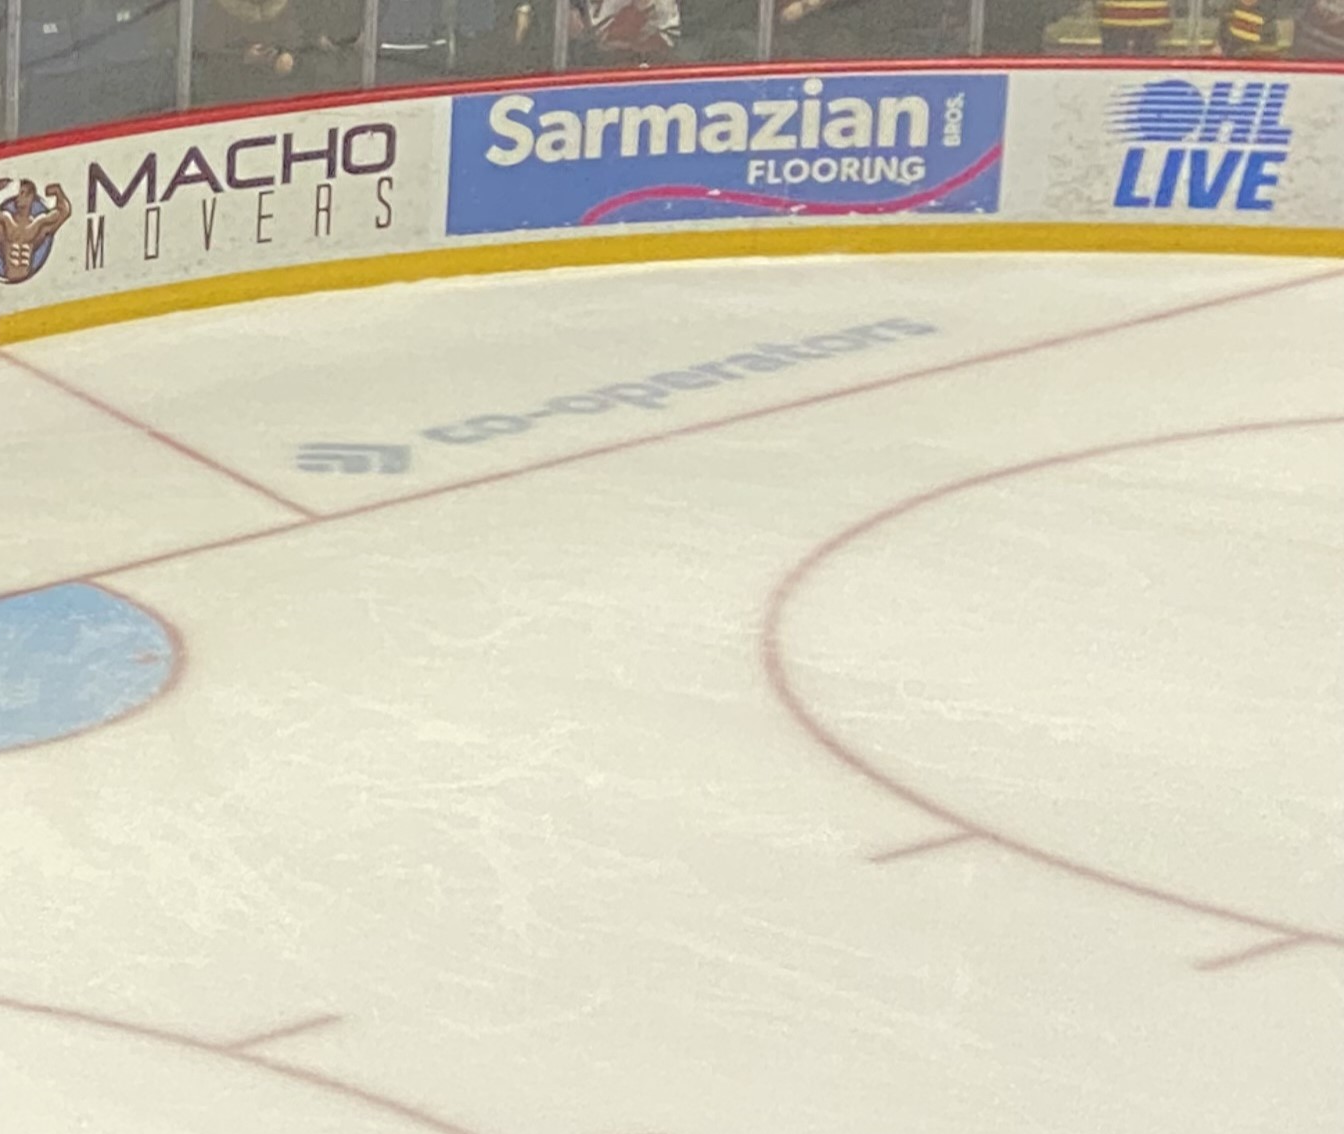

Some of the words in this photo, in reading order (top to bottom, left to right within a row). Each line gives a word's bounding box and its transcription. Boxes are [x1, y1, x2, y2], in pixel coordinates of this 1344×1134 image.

[484, 77, 931, 167] Sarmazian
[1104, 79, 1293, 144] OHL
[86, 122, 397, 214] MACHO
[746, 155, 927, 186] FLOORING
[1113, 147, 1289, 210] LIVE
[85, 176, 394, 271] MOVERS
[422, 317, 938, 446] co-operators
